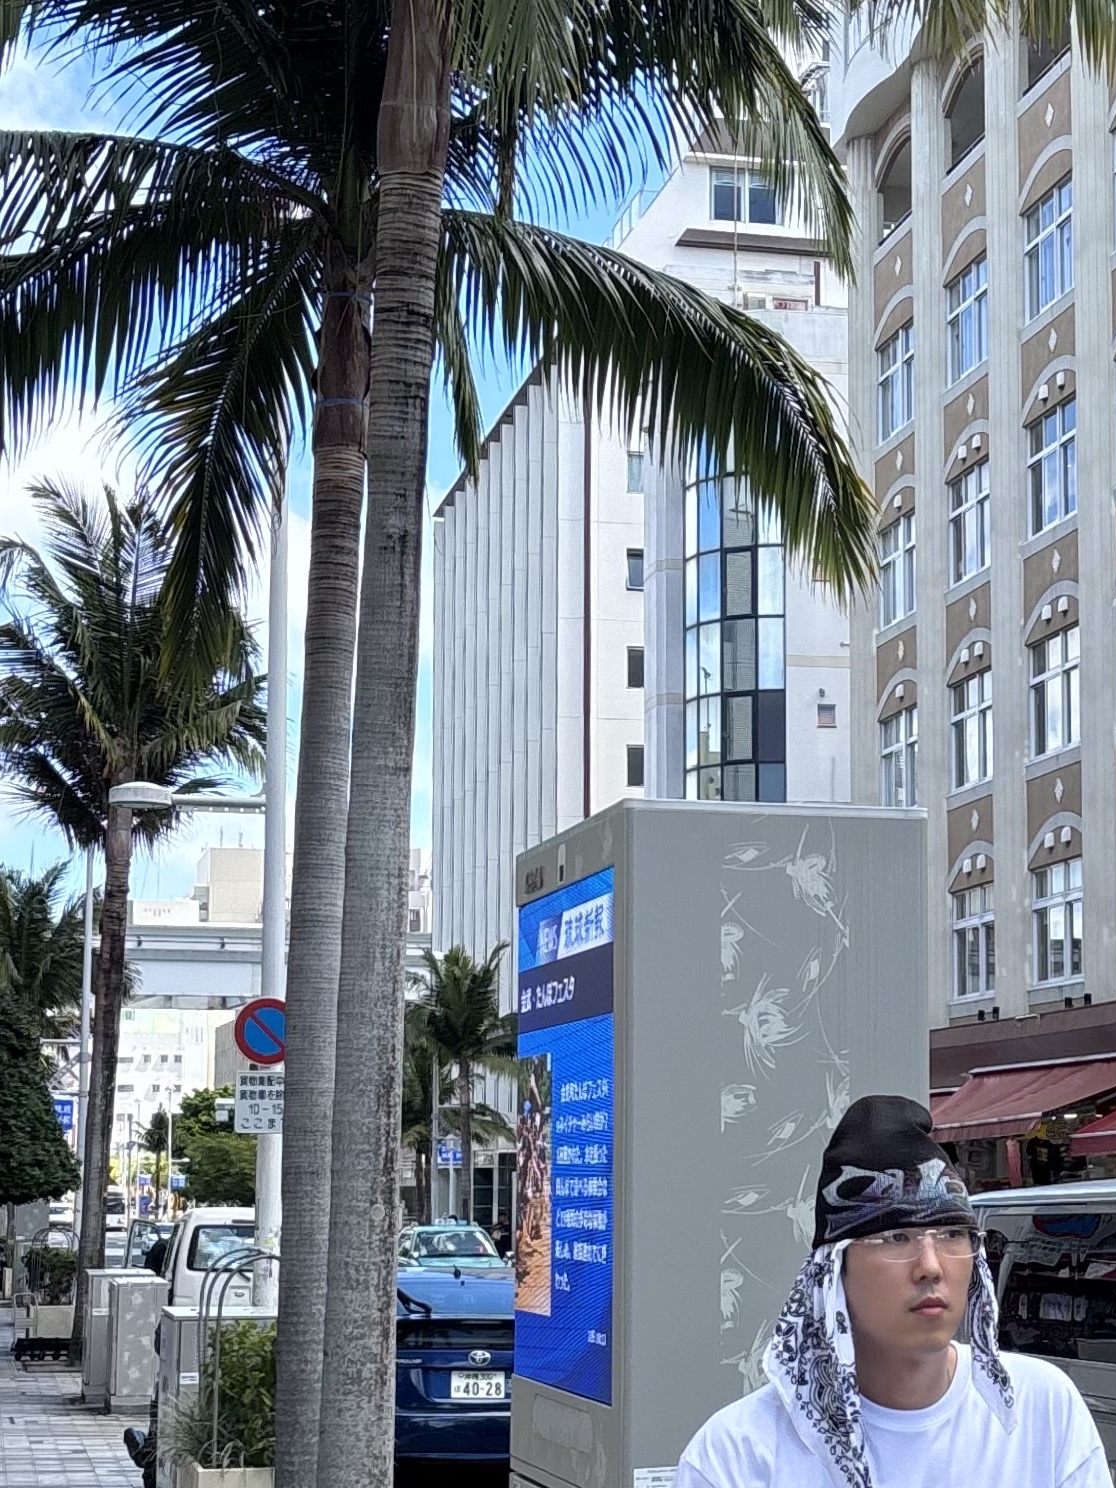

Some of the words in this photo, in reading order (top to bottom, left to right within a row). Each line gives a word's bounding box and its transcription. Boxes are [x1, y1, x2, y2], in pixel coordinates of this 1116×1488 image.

[240, 1117, 282, 1130] ここま
[462, 1381, 502, 1397] 40-28
